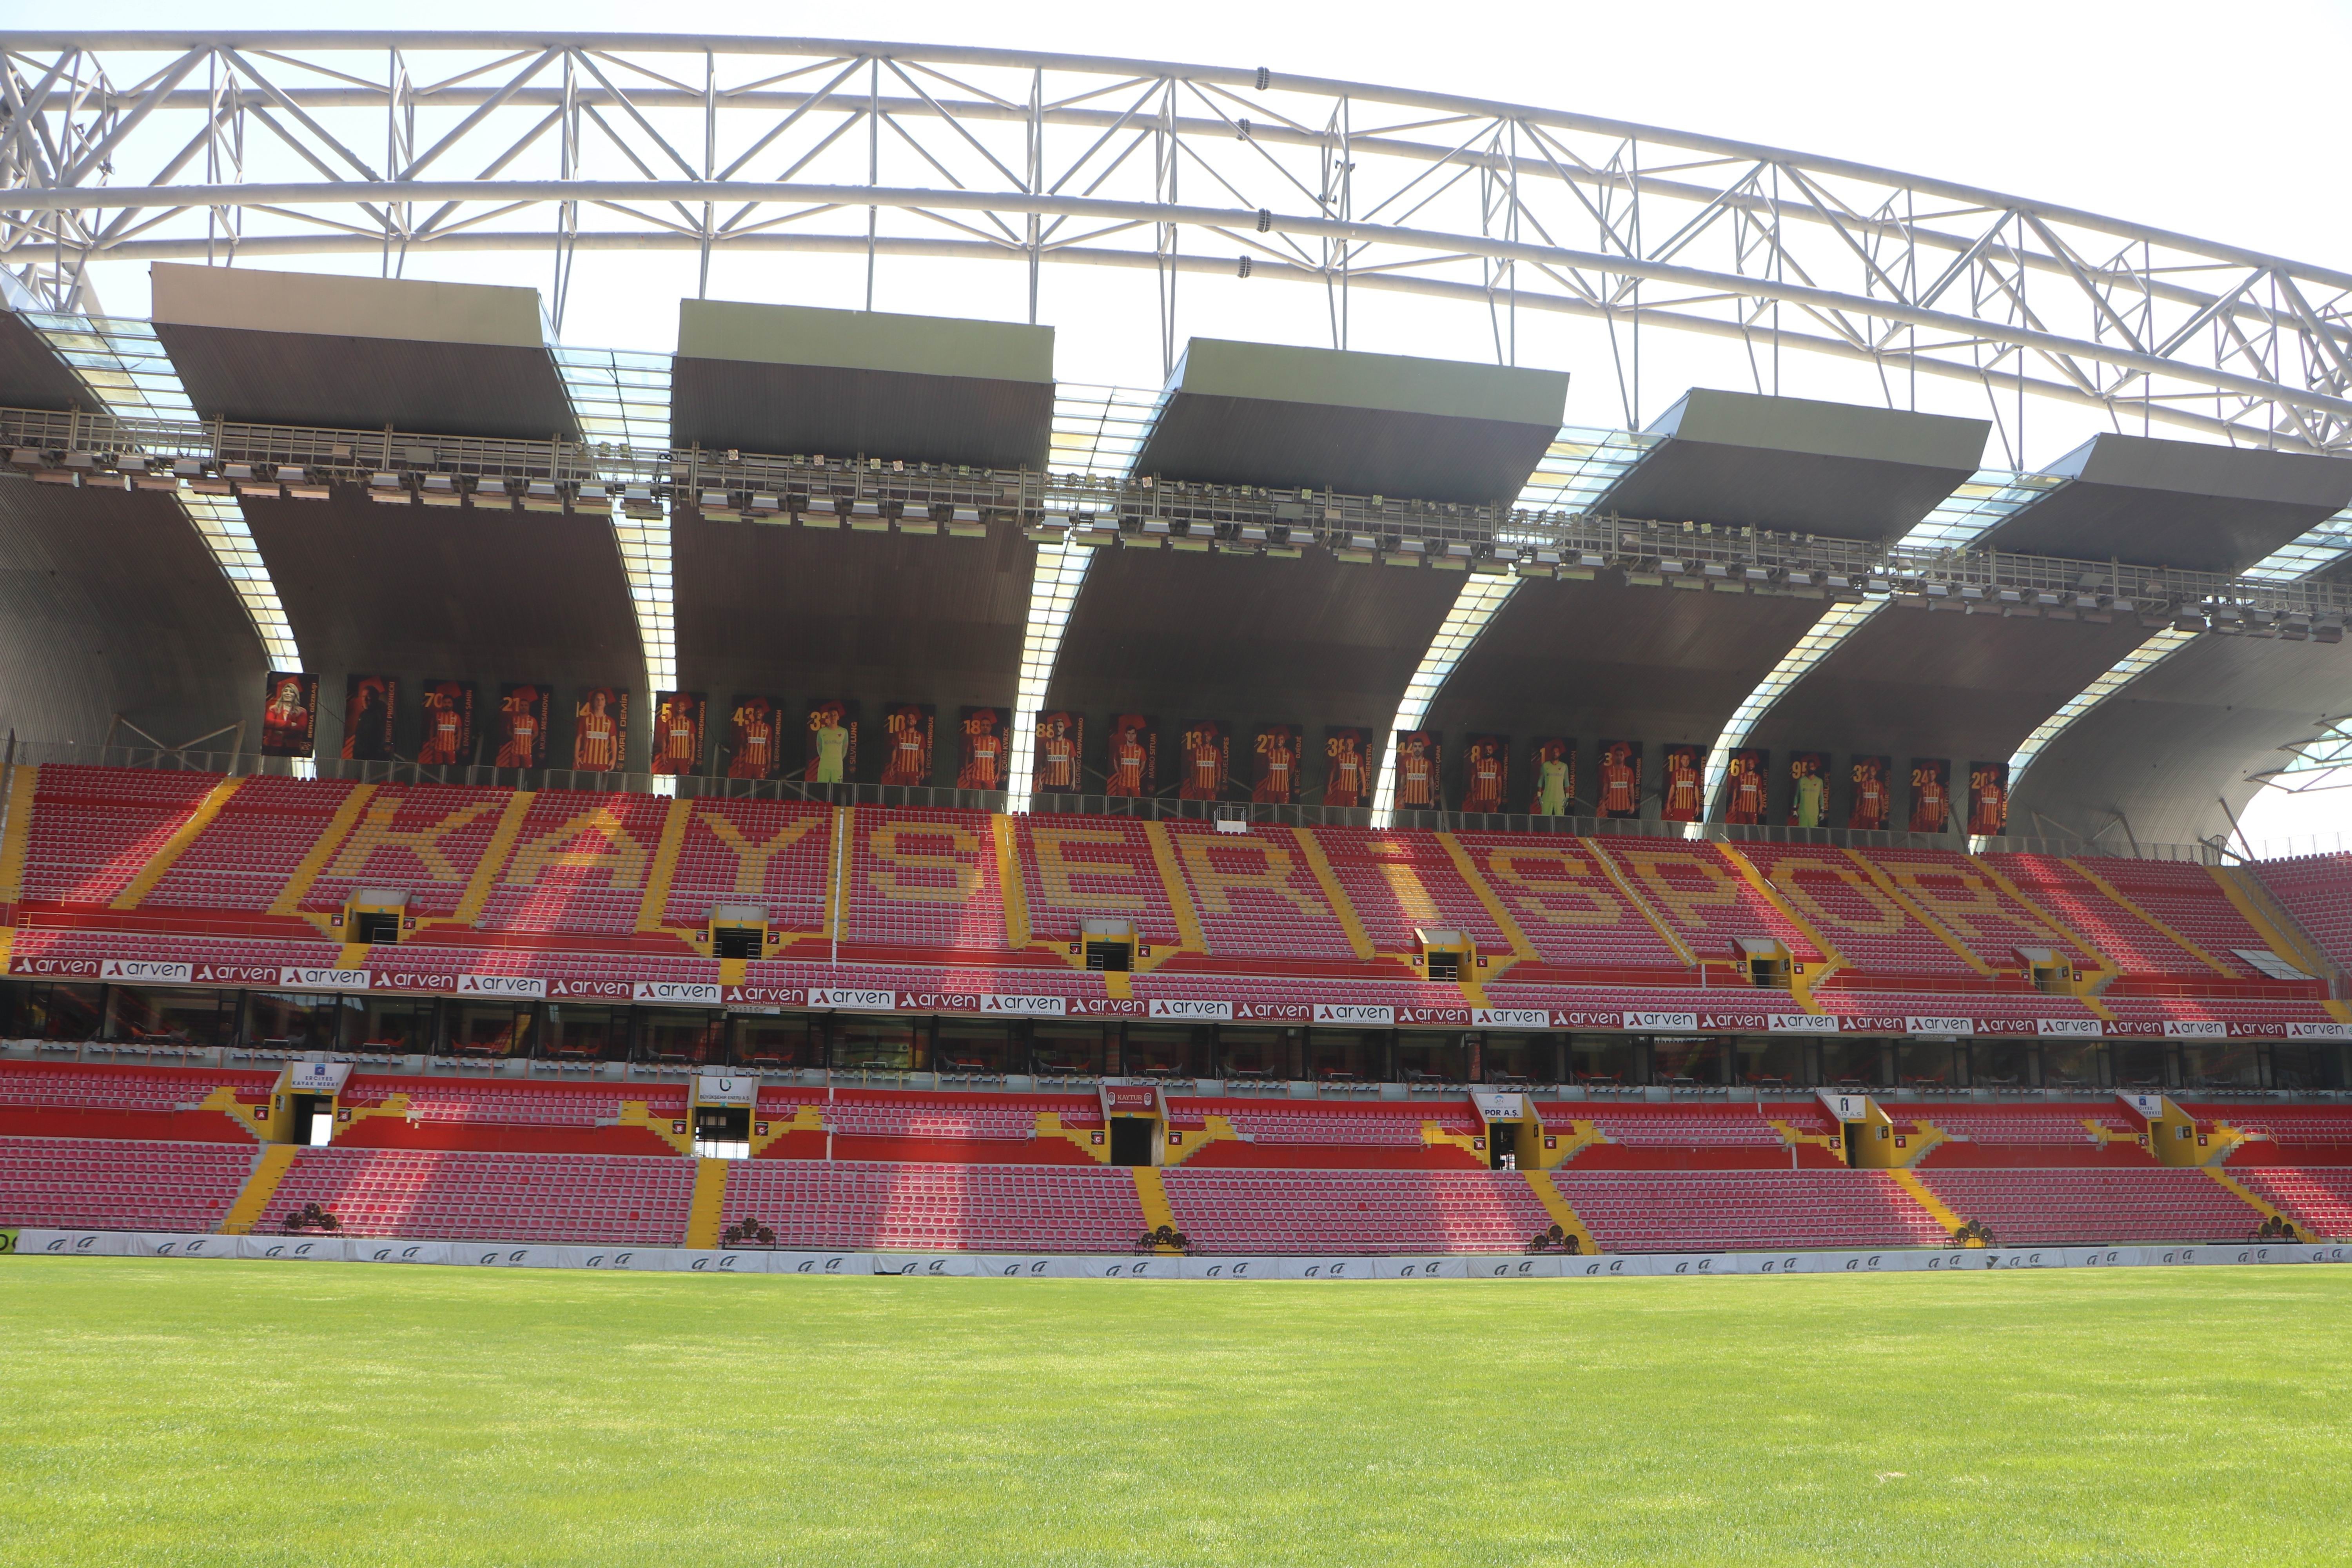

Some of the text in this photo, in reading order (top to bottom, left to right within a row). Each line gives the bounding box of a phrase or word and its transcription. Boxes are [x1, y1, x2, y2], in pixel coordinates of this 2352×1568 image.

[309, 682, 318, 712] GÖZBAŞI
[424, 693, 443, 708] 70
[502, 697, 520, 711] 21
[576, 701, 590, 718] 14
[619, 694, 628, 727] DEMİR
[661, 703, 672, 723] 5
[733, 707, 754, 726] 43
[887, 714, 906, 733] 10
[964, 720, 981, 734] 18
[1036, 723, 1054, 738] 88
[1185, 731, 1202, 750] 13
[1257, 734, 1276, 753] 27
[1397, 742, 1413, 756] 44
[1539, 747, 1546, 763] 1
[1604, 752, 1612, 766] 3
[1668, 754, 1680, 772] 11
[1730, 758, 1746, 777] 61
[1912, 769, 1929, 787] 24
[1971, 772, 1988, 789] 20
[36, 960, 96, 973] arven
[127, 963, 186, 976] arven
[216, 967, 276, 980] arven
[306, 971, 365, 984] arven
[394, 973, 453, 987] arven
[483, 978, 541, 992] arven
[570, 981, 629, 995] arven
[658, 985, 716, 998] arven
[746, 988, 803, 1001] arven
[833, 991, 890, 1004] arven
[919, 994, 976, 1007] arven
[1004, 997, 1060, 1010] arven
[1089, 1000, 1145, 1012] arven
[1172, 1002, 1227, 1014] arven
[1255, 1004, 1309, 1017] arven
[1336, 1007, 1389, 1019] arven
[1416, 1009, 1468, 1021] arven
[1494, 1011, 1544, 1022] arven
[1570, 1013, 1620, 1024] arven
[1644, 1014, 1693, 1025] arven
[1717, 1015, 1764, 1026] arven
[1788, 1016, 1835, 1027] arven
[1857, 1017, 1903, 1028] arven
[1925, 1019, 1969, 1030] arven
[1991, 1020, 2034, 1031] arven
[2055, 1021, 2098, 1031] arven
[2119, 1022, 2161, 1032] arven
[2181, 1023, 2223, 1033] arven
[2243, 1024, 2284, 1034] arven
[2303, 1024, 2344, 1034] arven
